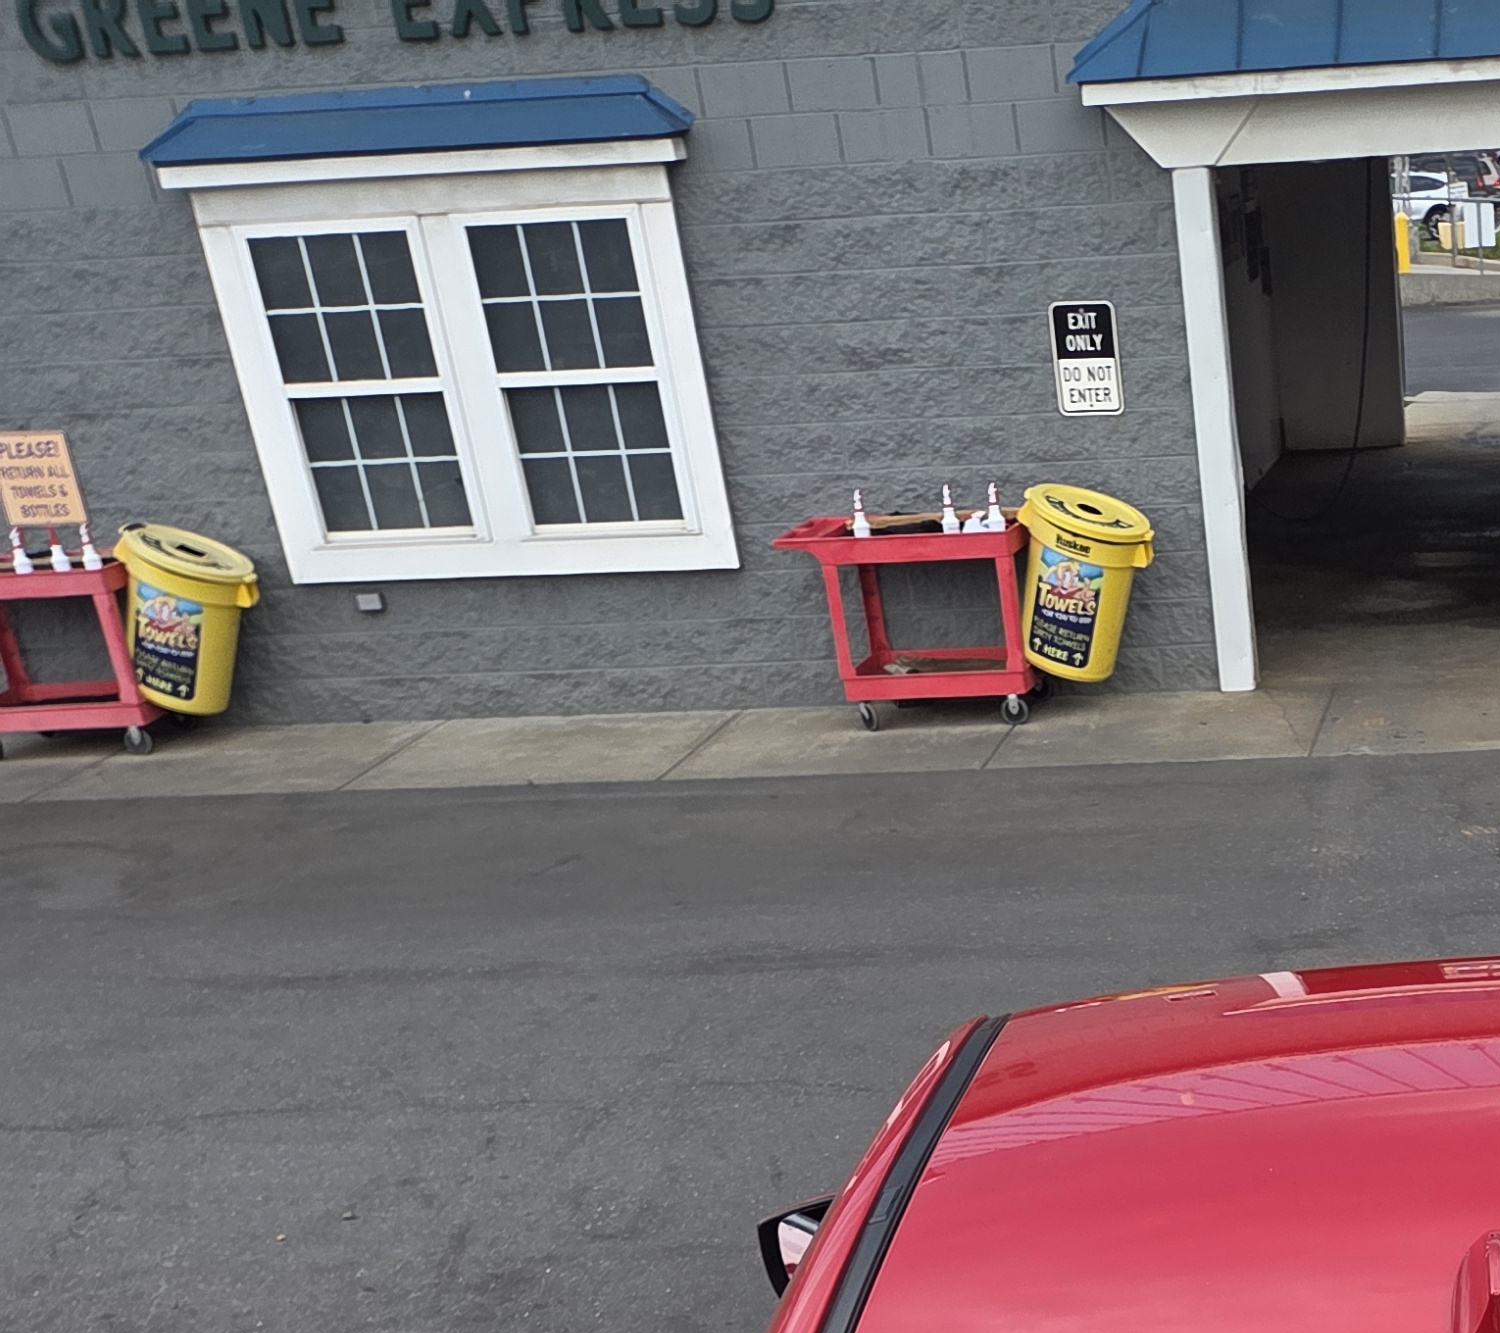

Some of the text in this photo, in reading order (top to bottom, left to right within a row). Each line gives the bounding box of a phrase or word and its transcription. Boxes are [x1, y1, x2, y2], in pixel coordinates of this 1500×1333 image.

[15, 0, 345, 65] GREENE
[1066, 312, 1097, 330] EXIT
[1065, 333, 1103, 352] ONLY
[1063, 365, 1112, 382] DO NOT
[1069, 387, 1112, 404] ENTER
